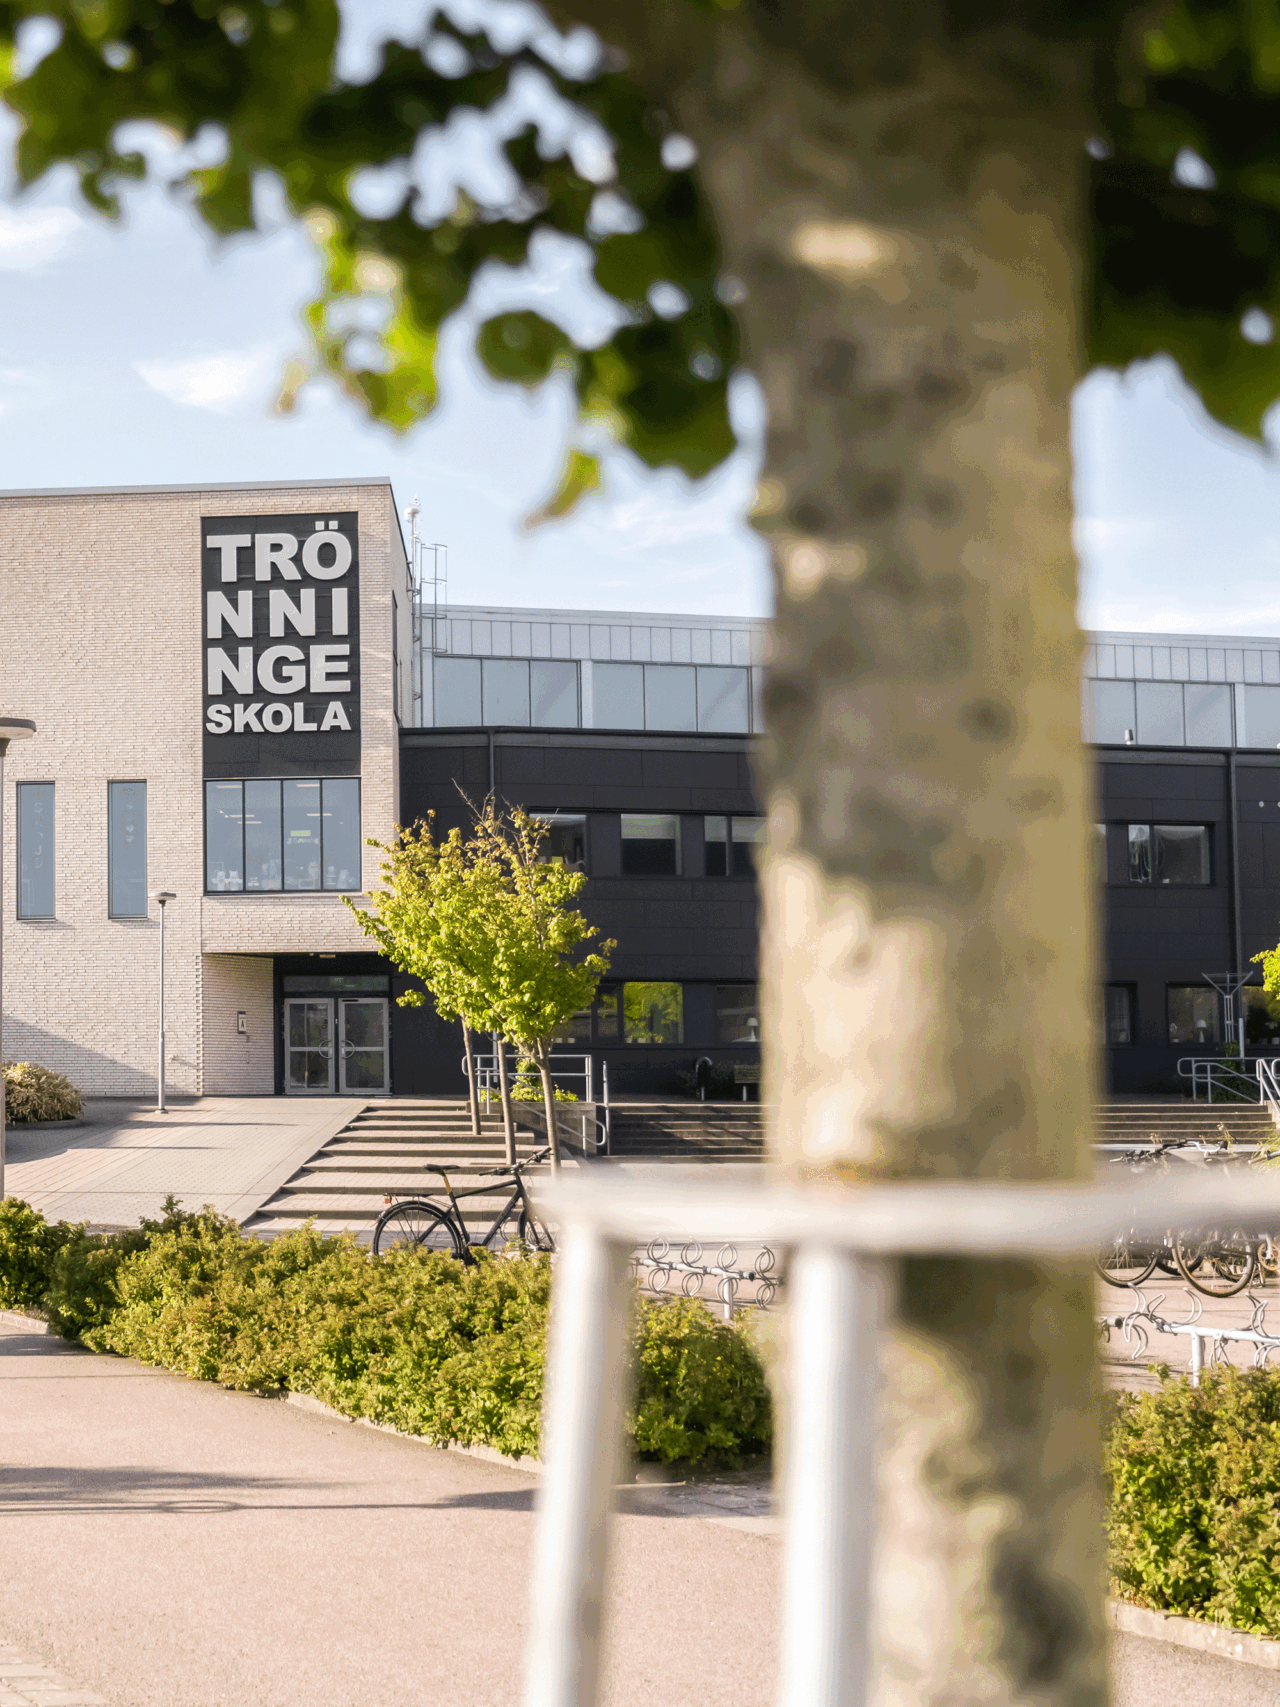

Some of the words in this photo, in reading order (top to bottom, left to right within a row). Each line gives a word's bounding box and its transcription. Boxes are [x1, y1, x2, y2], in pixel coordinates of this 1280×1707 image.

[206, 520, 352, 583] TRÖ
[207, 644, 352, 695] NGE
[205, 701, 352, 734] SKOLA
